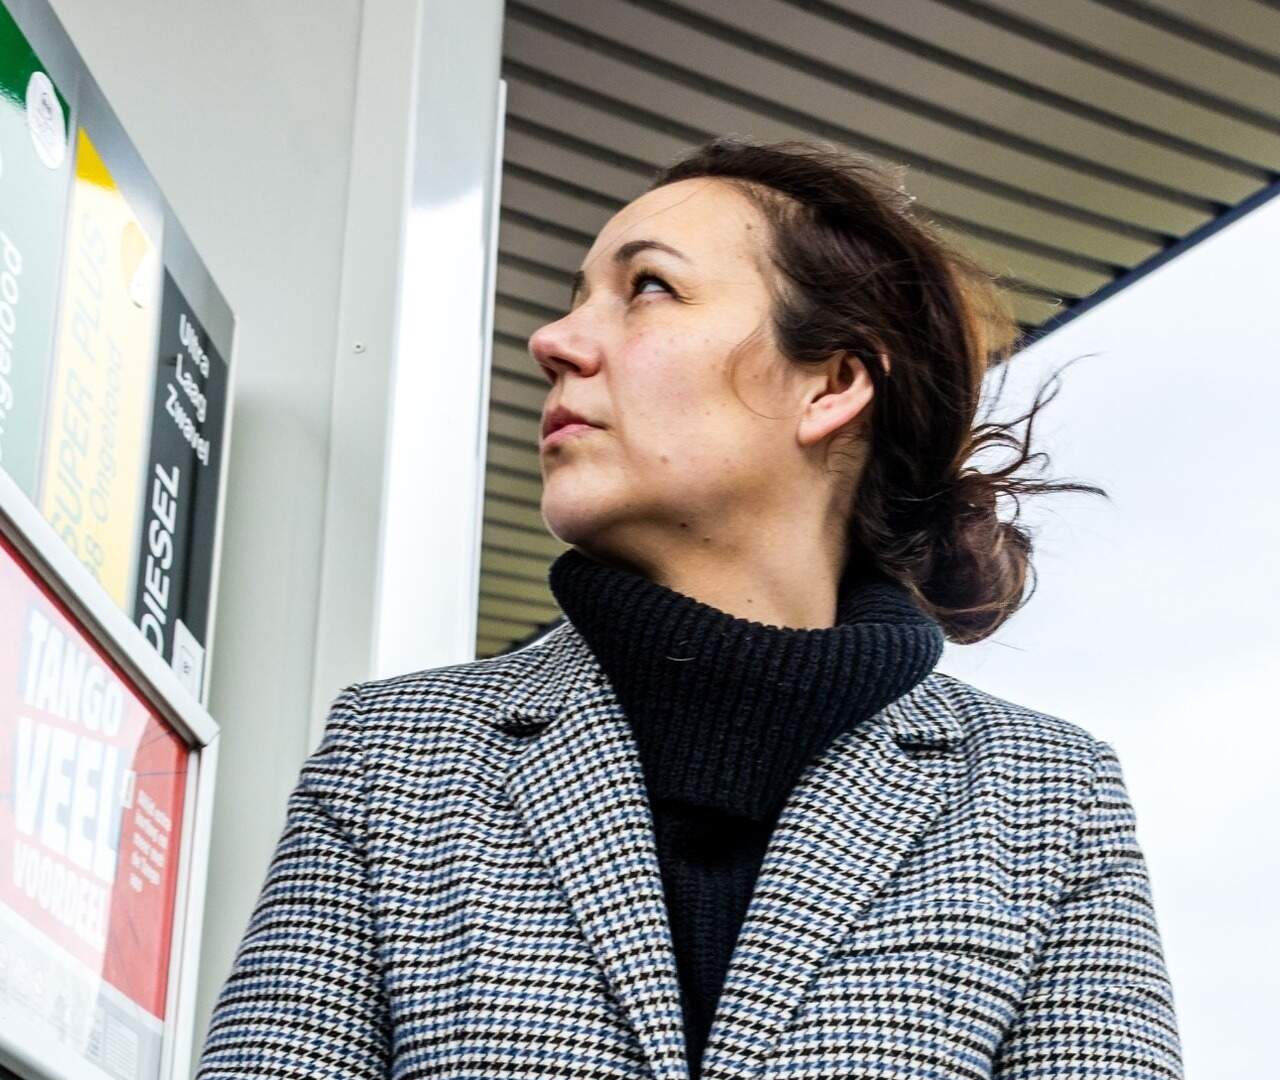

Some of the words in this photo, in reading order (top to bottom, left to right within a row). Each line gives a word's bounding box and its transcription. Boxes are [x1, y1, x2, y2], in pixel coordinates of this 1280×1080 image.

[71, 211, 107, 362] PLUS
[166, 382, 211, 467] Zwavel
[140, 463, 180, 657] DIESEL
[24, 607, 124, 738] TANGO
[16, 715, 120, 885] VEEL
